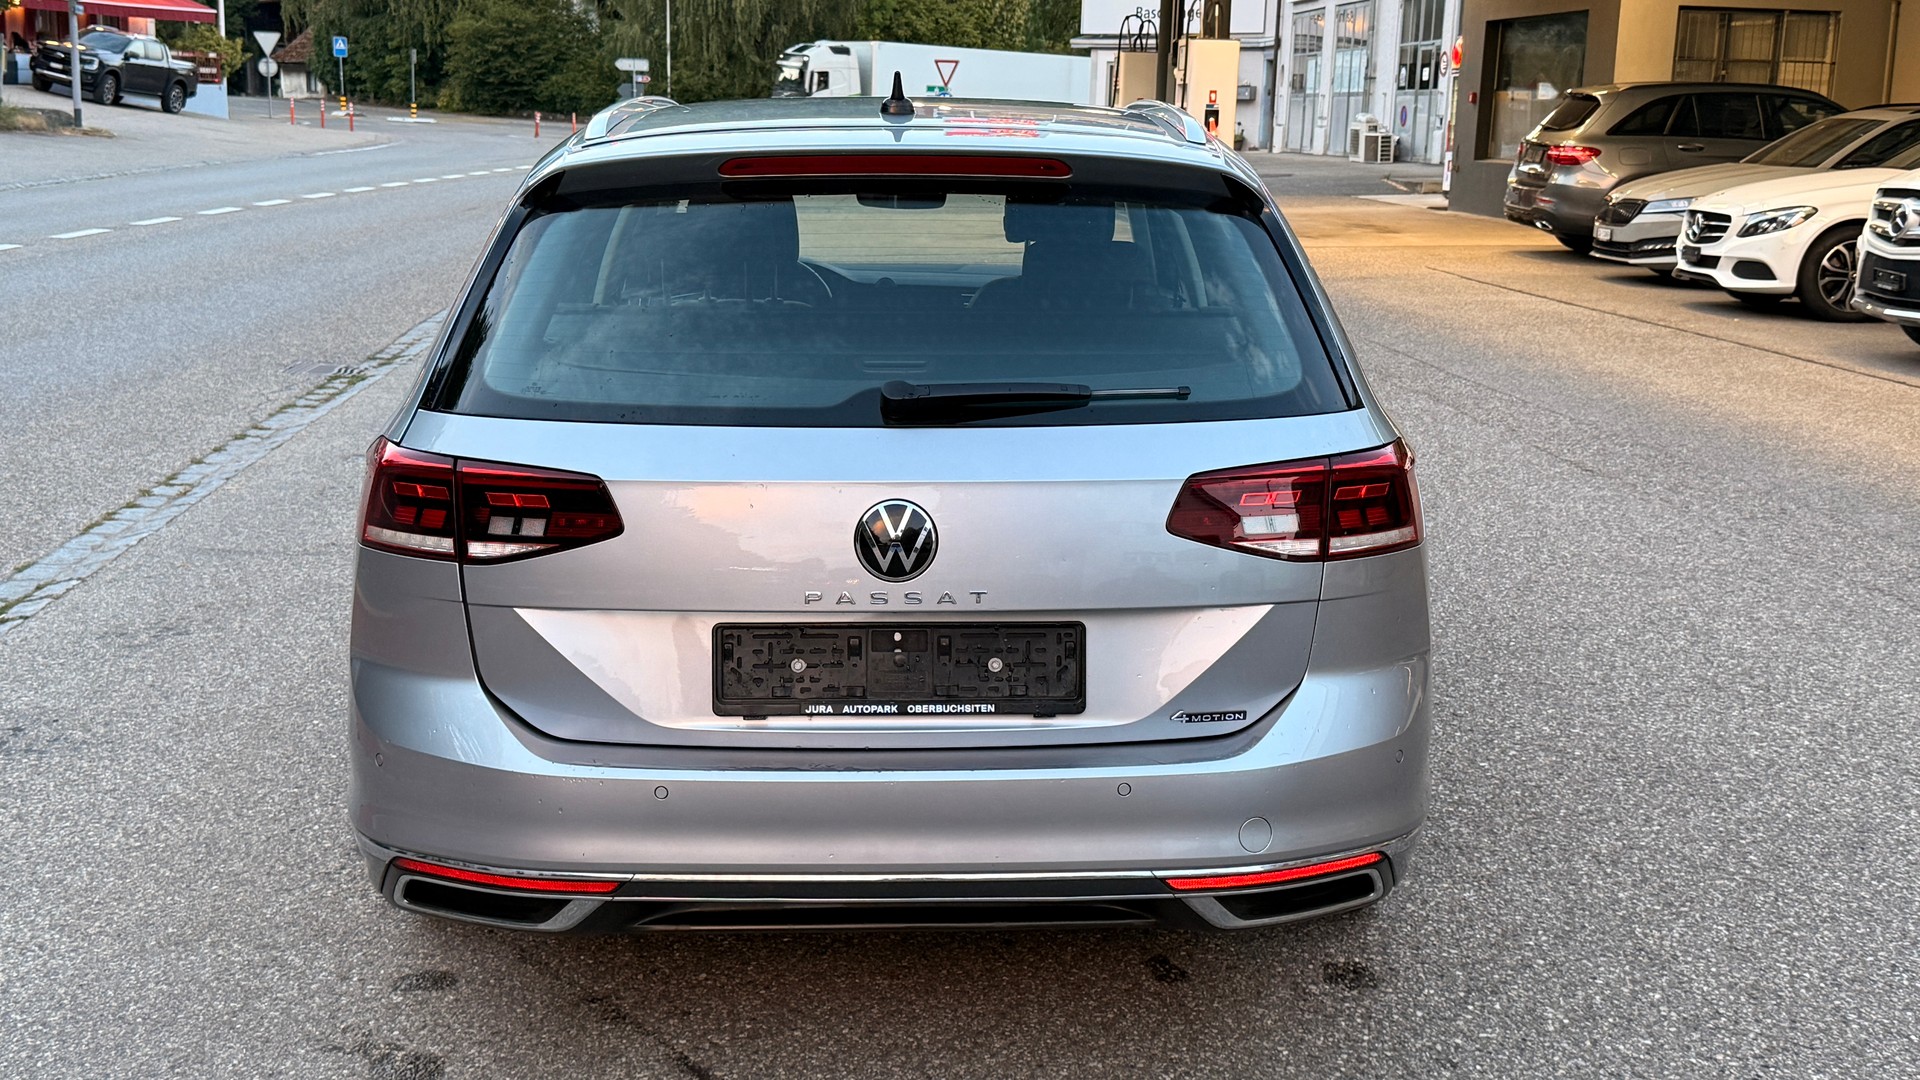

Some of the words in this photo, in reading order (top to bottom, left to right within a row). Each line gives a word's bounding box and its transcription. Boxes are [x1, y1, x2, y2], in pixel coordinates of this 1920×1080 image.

[861, 502, 933, 575] VW
[804, 591, 988, 605] PASSAT
[805, 704, 834, 714] JURA
[842, 704, 898, 714] AUTOPARK
[907, 704, 995, 714] OBERBUCHSITEN
[1171, 710, 1244, 723] 4MOTION
